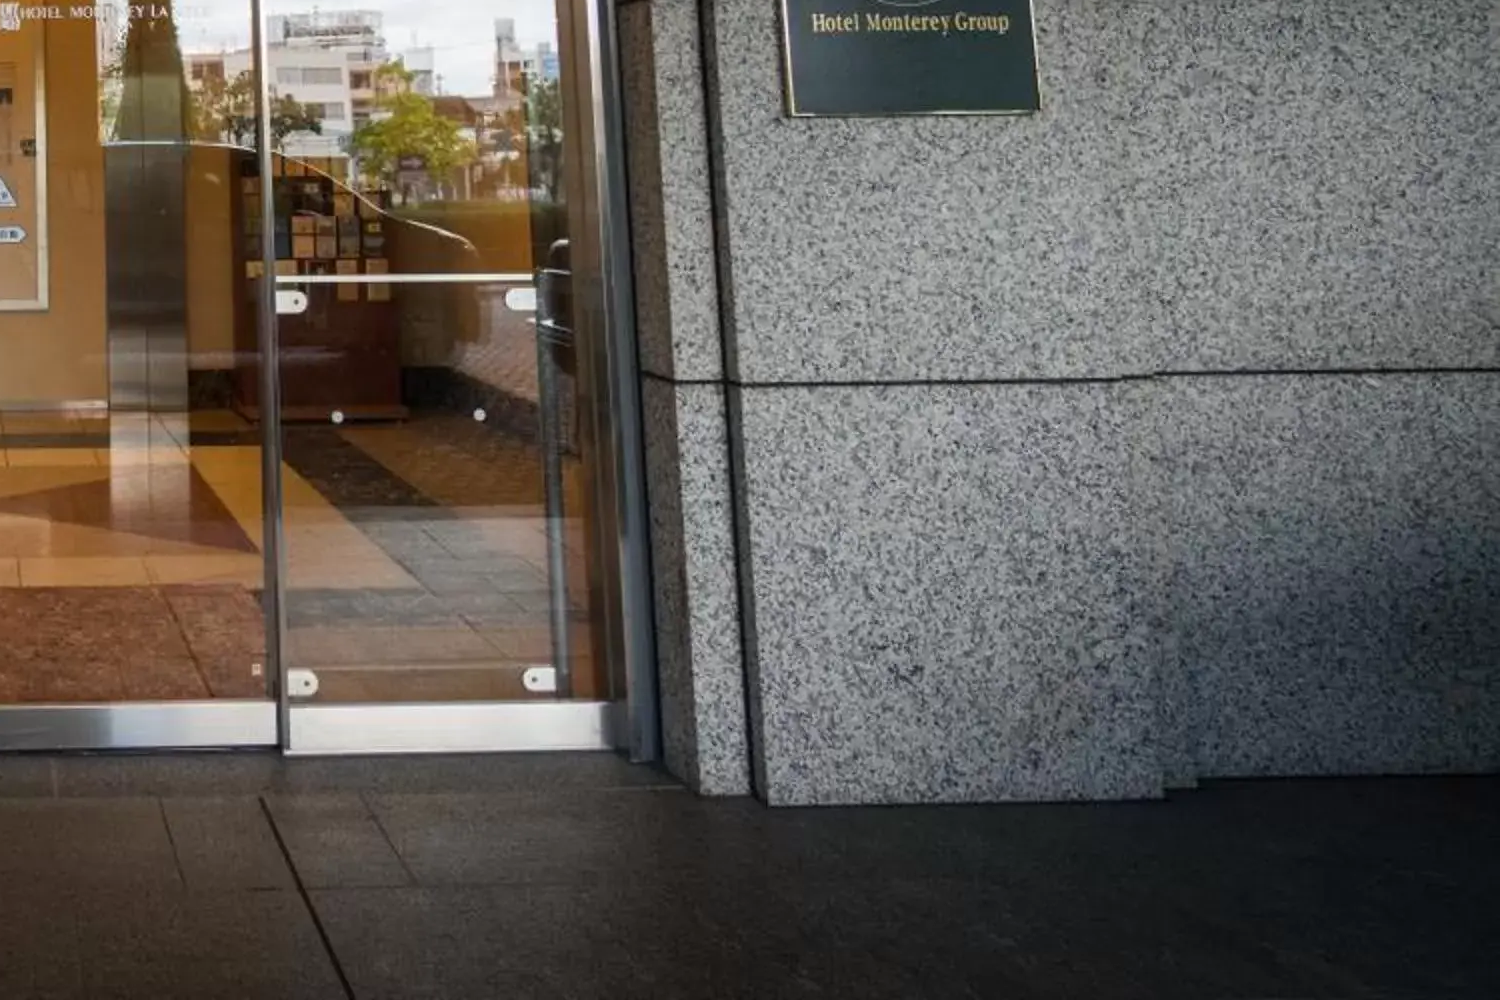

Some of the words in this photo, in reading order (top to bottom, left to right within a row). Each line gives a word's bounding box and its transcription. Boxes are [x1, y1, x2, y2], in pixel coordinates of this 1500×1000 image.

[20, 4, 64, 19] HOTEL
[811, 13, 860, 33] Hotel
[866, 13, 950, 36] Monterey
[954, 11, 1010, 35] Group
